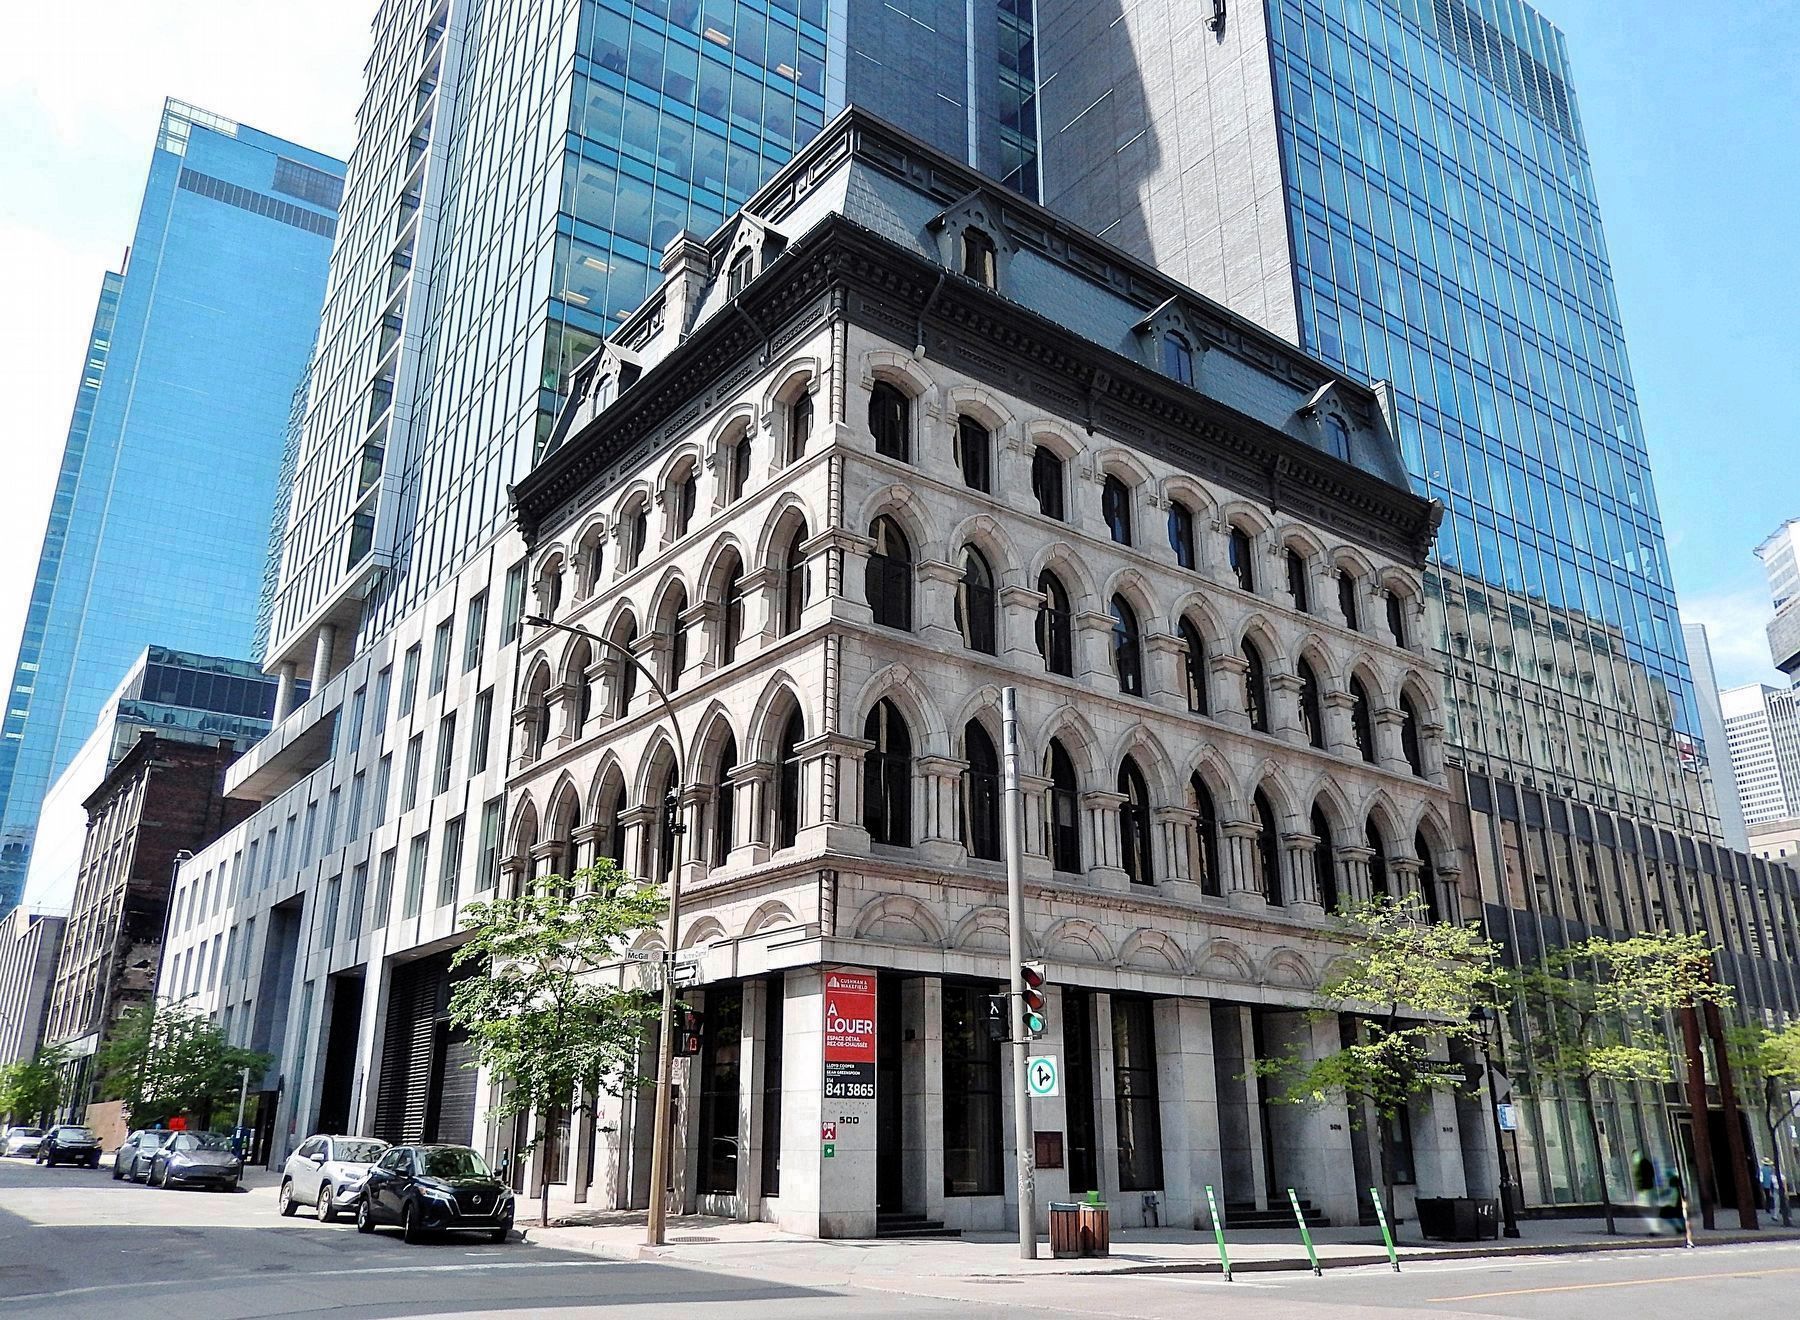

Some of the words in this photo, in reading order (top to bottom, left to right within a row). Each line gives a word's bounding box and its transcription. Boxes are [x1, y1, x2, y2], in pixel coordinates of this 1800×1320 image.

[628, 952, 649, 960] McGill
[827, 1000, 838, 1016] À
[827, 1018, 873, 1035] LOUER
[839, 1116, 860, 1124] 500
